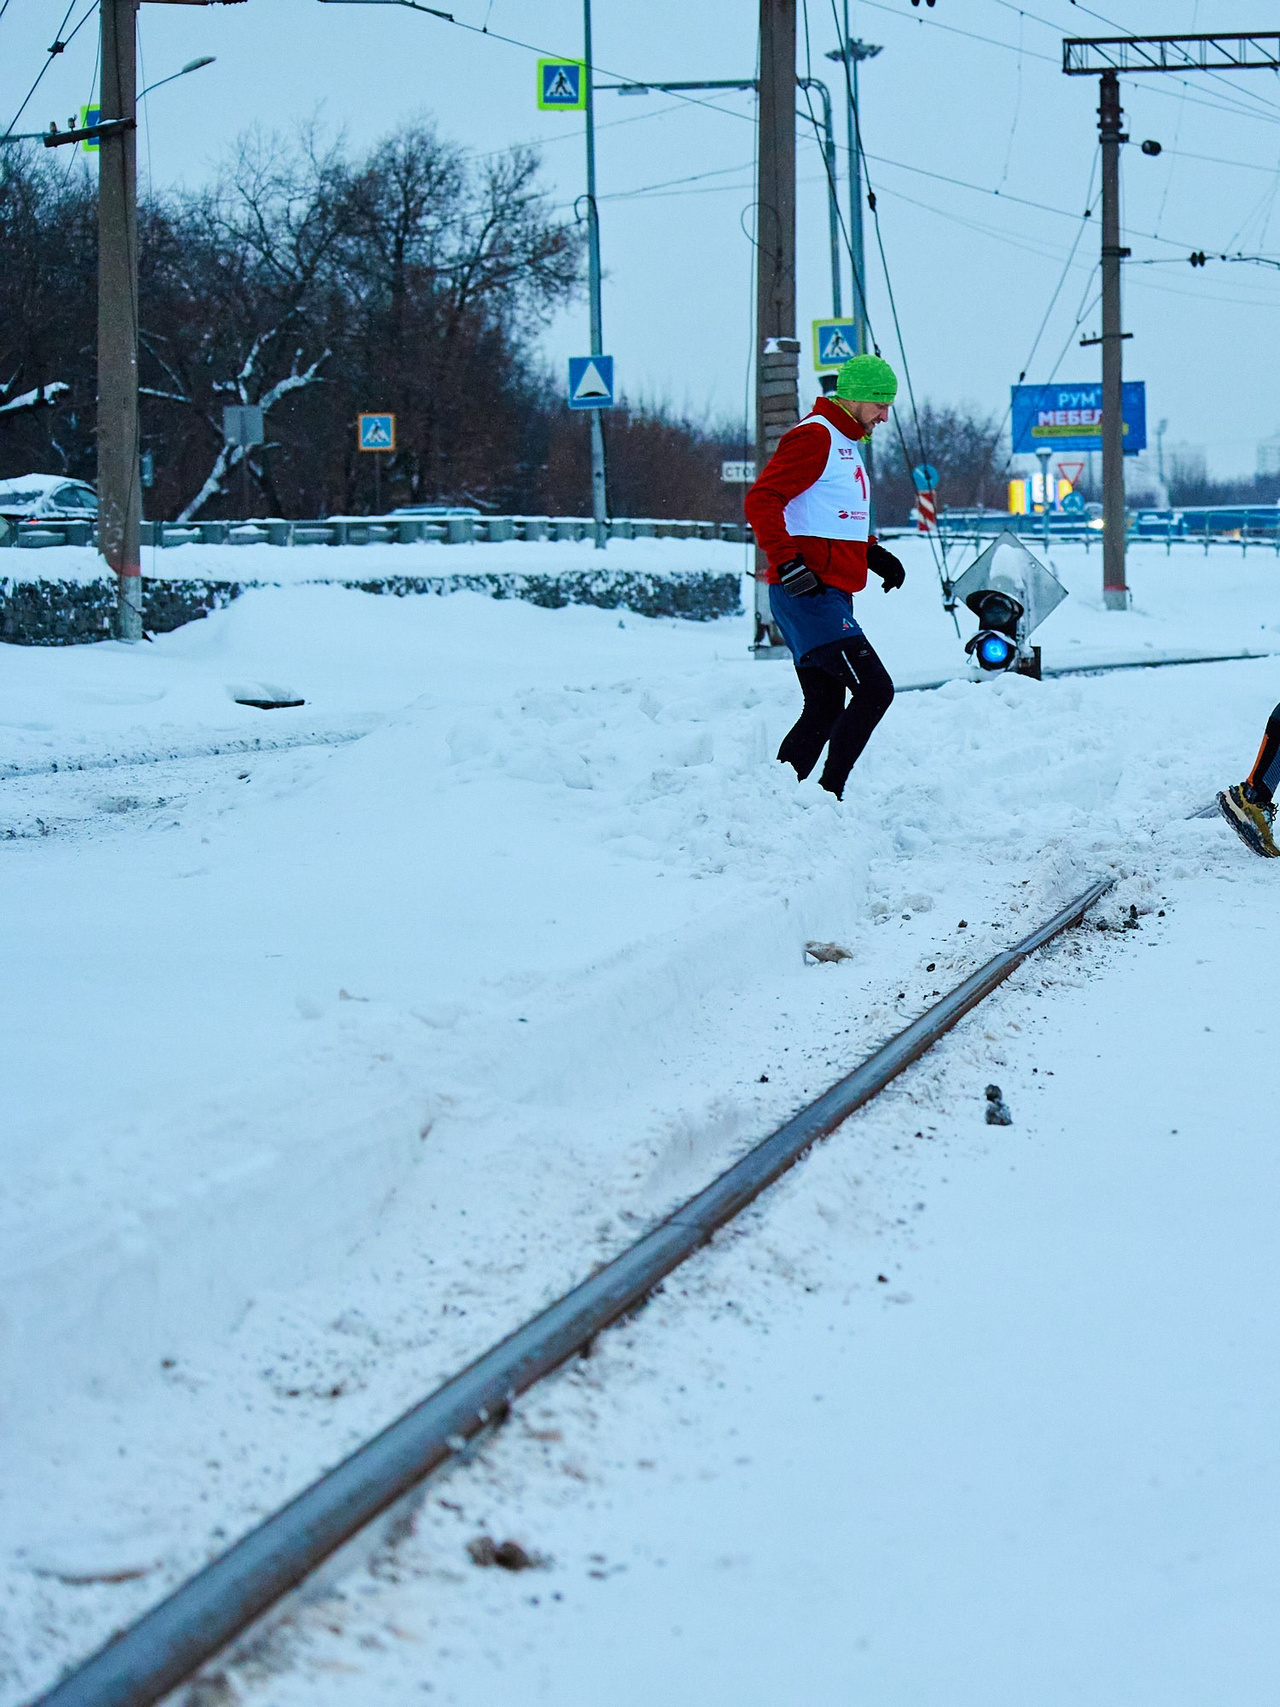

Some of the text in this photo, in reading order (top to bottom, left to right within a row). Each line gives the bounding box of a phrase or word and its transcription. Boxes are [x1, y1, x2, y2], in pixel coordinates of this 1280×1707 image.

[1058, 392, 1096, 407] РУМ
[1038, 409, 1103, 427] МЕБЕЛ
[853, 465, 868, 501] 1
